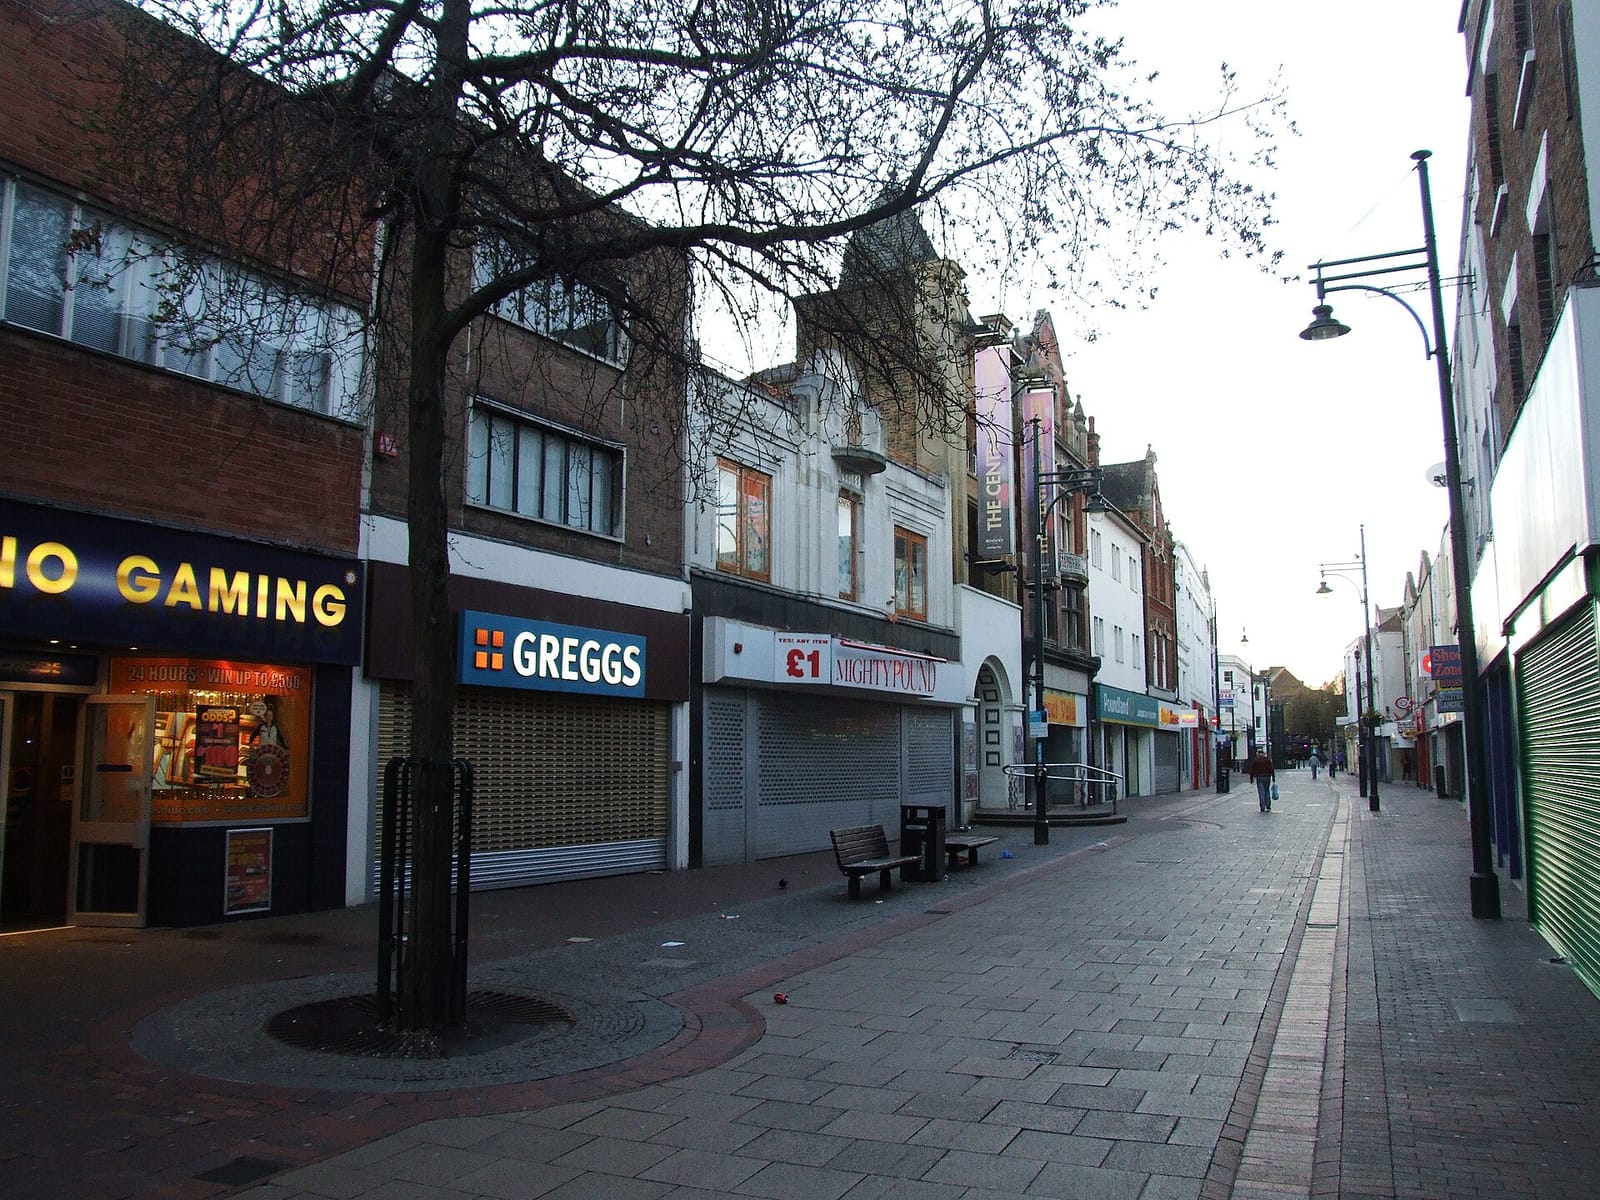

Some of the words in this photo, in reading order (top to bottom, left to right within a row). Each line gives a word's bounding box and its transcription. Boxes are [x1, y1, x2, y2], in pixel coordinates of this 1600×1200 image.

[987, 501, 1002, 531] THE
[116, 554, 346, 627] GAMING
[513, 631, 641, 687] GREGGS
[787, 649, 820, 678] £1
[128, 666, 144, 681] 24
[149, 666, 196, 682] HOURS
[208, 668, 233, 685] WIN
[235, 671, 251, 686] UP
[253, 671, 268, 687] TO
